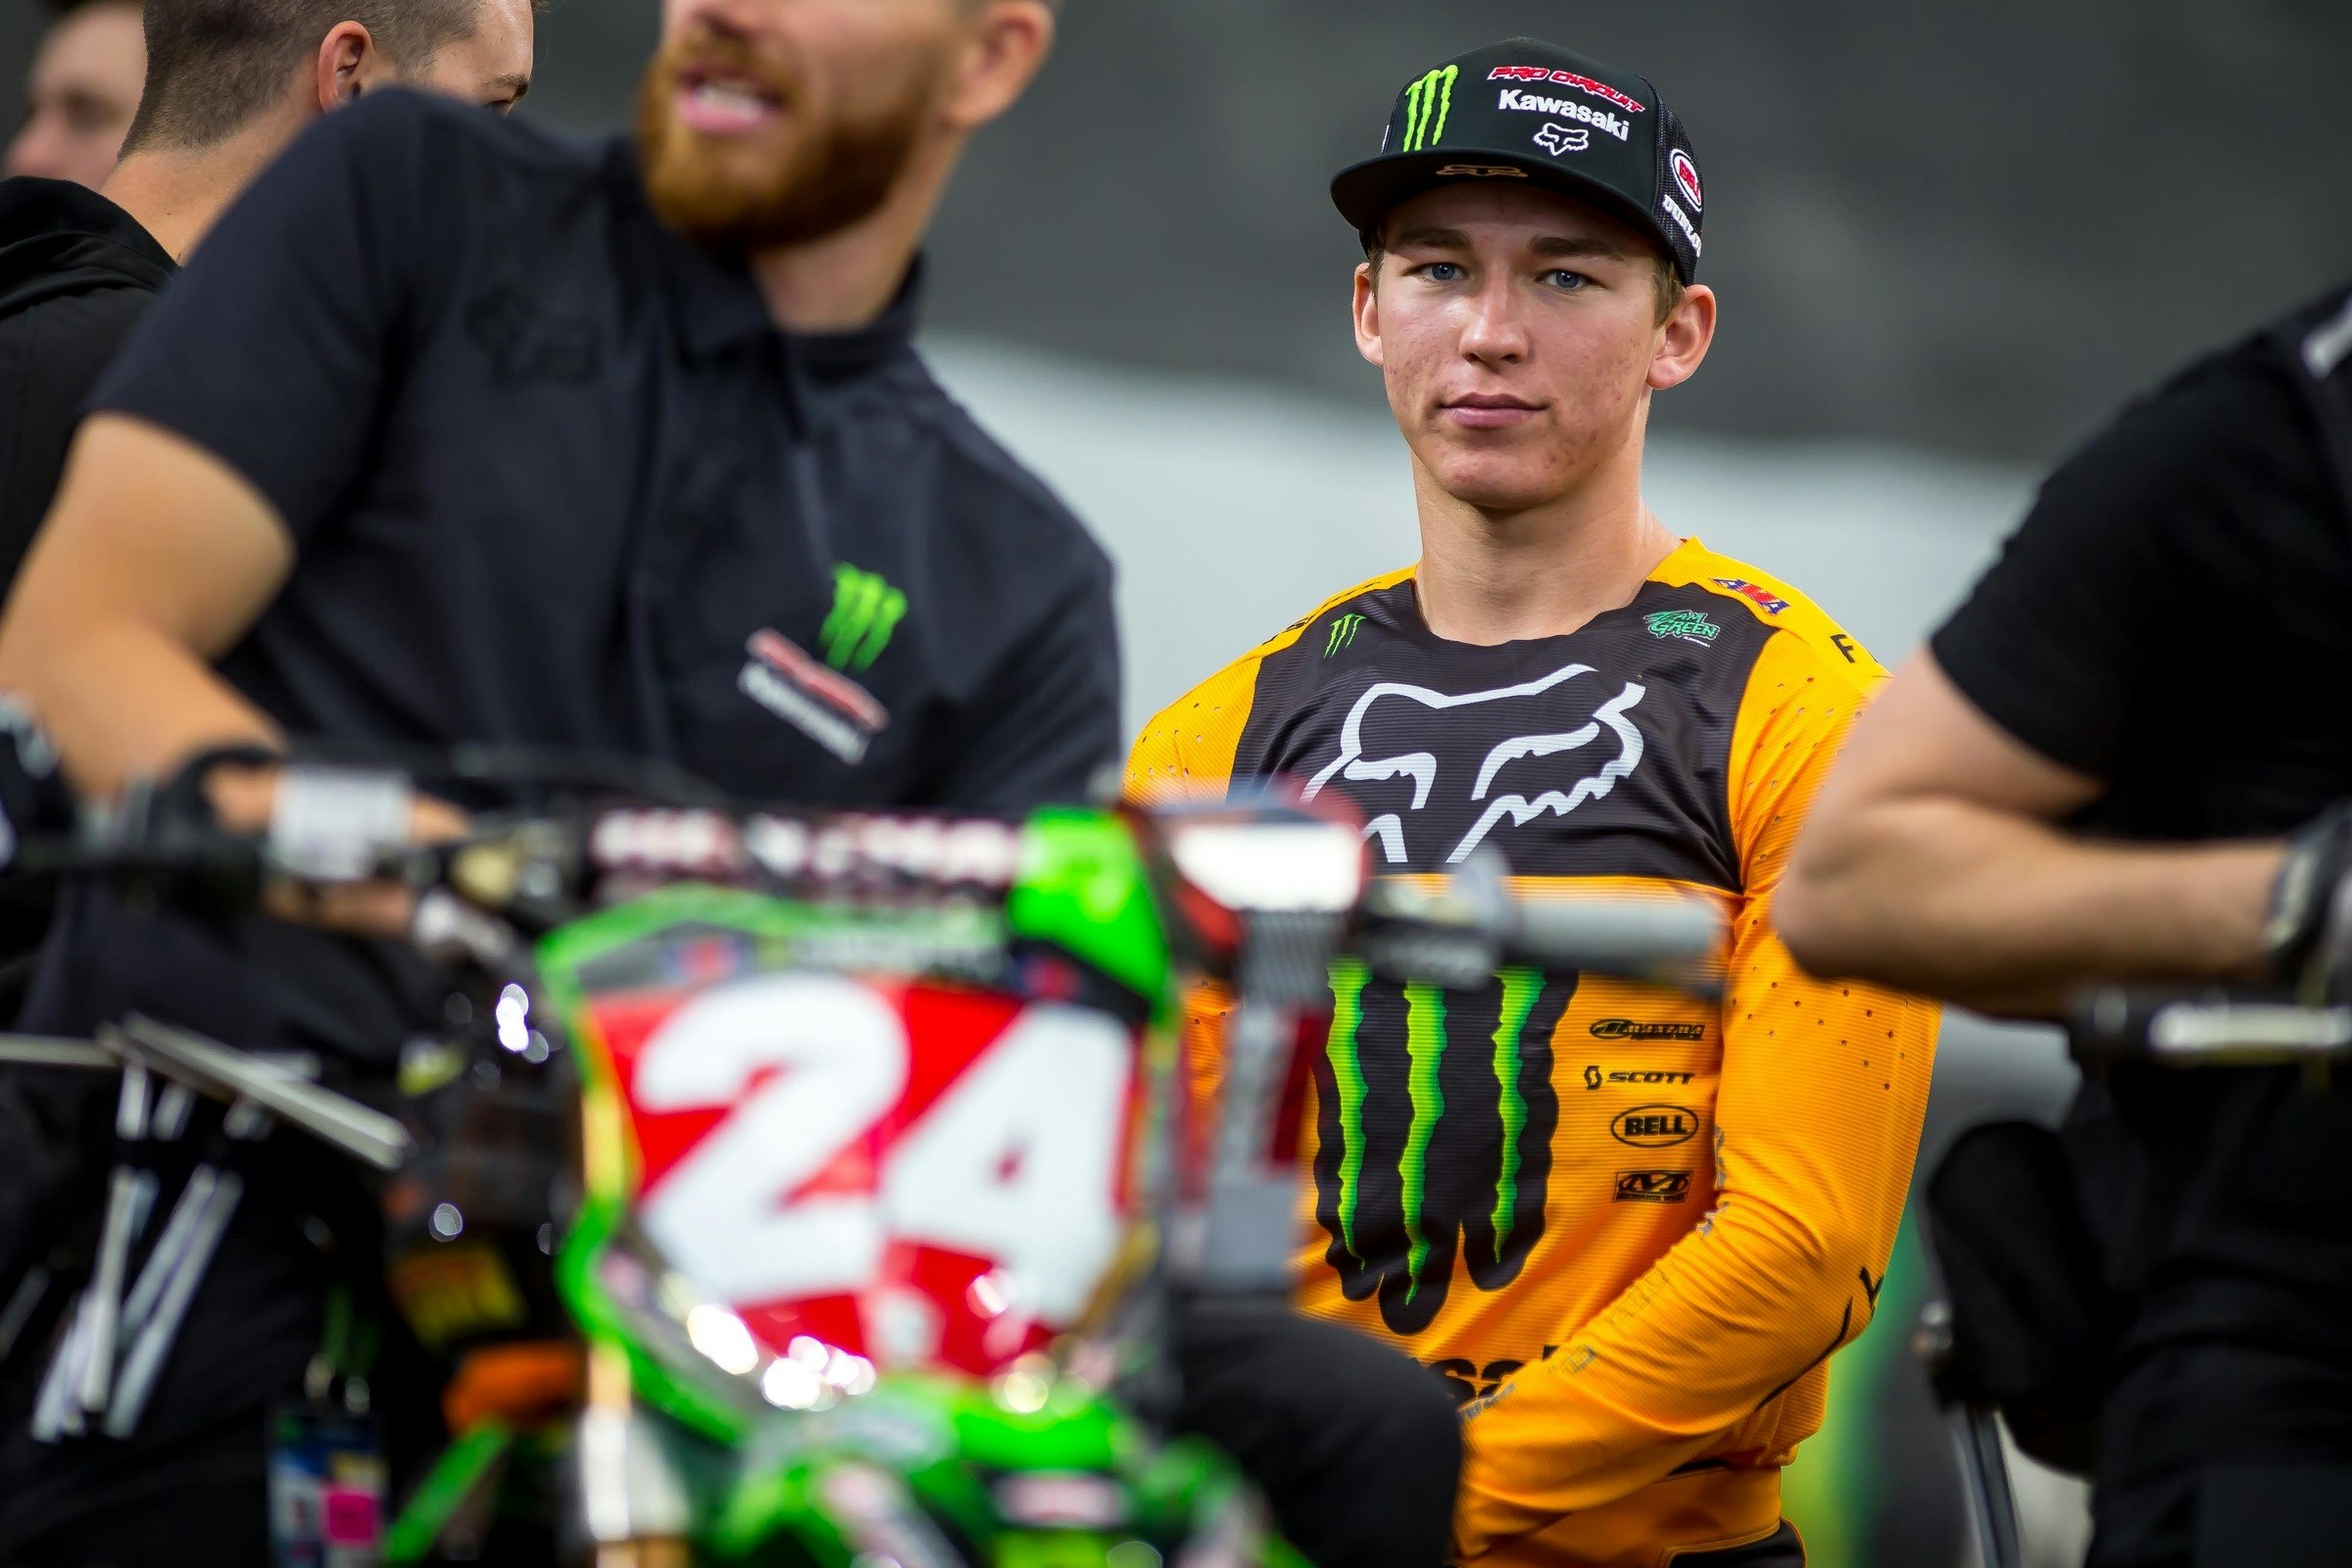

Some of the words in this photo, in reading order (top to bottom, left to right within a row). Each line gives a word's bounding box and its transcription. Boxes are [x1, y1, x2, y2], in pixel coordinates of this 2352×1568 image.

[1487, 66, 1550, 81] PRO
[1548, 70, 1645, 113] CIRCUIT
[1498, 89, 1630, 141] Kawasaki
[1644, 610, 1707, 624] TEAM
[1649, 620, 1719, 638] GREEN
[1607, 1072, 1695, 1085] SCOTT
[1625, 1115, 1690, 1137] BELL
[632, 973, 1137, 1330] 24
